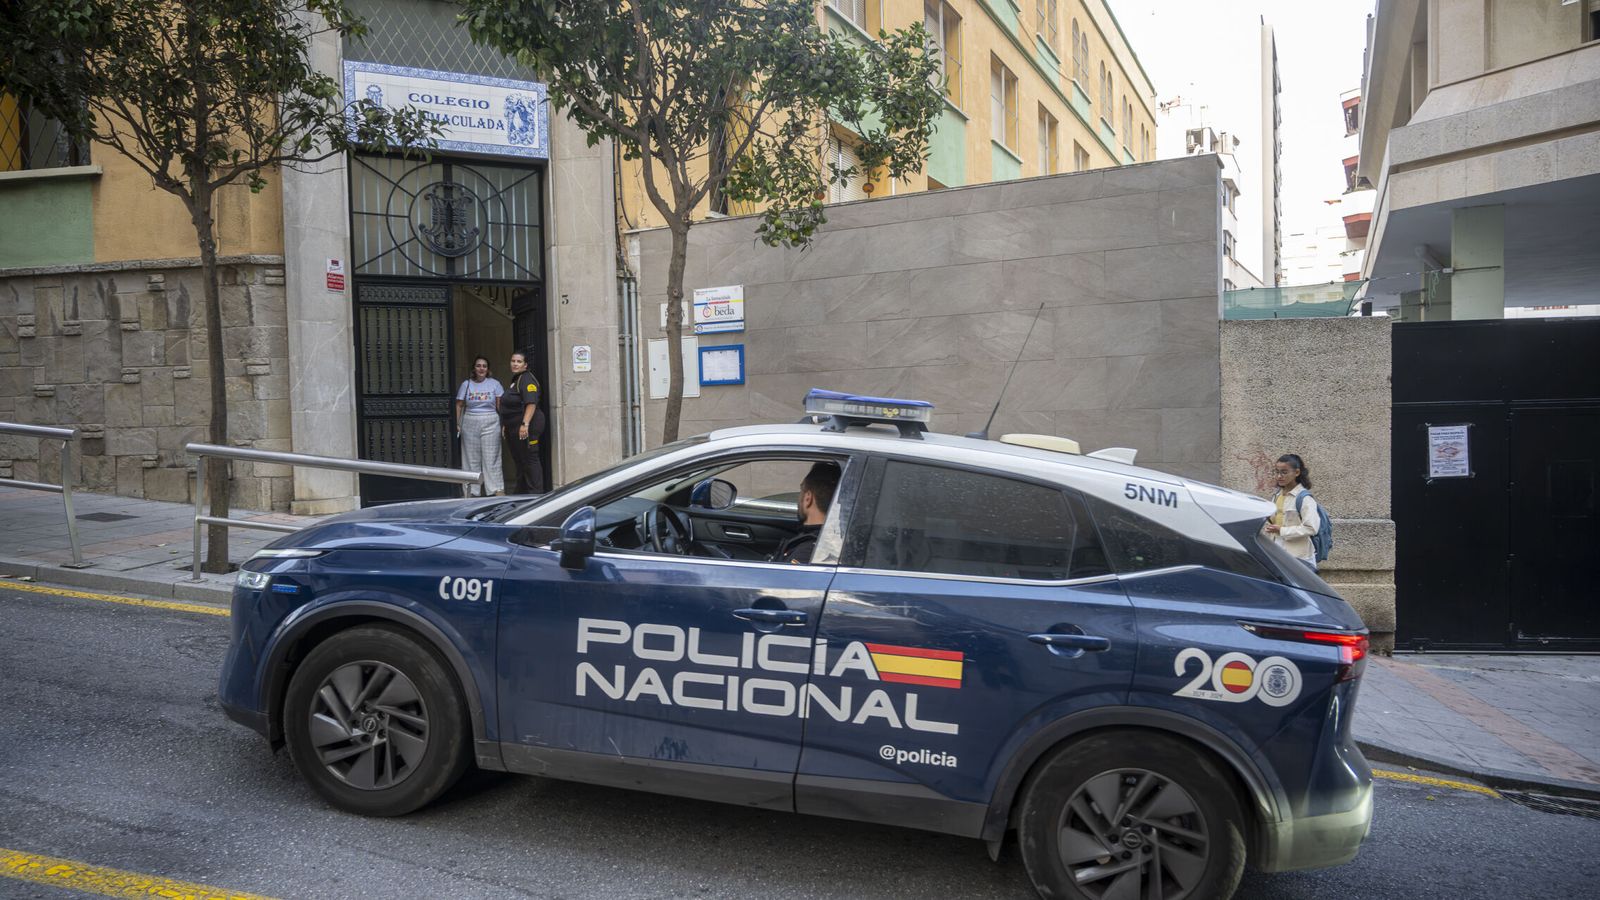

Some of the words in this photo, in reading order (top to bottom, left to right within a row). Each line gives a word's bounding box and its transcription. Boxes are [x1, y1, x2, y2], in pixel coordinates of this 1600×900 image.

[408, 92, 490, 110] COLEGIO
[418, 110, 505, 131] MACULADA
[714, 304, 735, 316] beda
[1124, 483, 1178, 509] 5NM
[452, 577, 493, 602] 091
[577, 617, 881, 681] POLICIA
[576, 661, 959, 735] NACIONAL
[879, 744, 958, 769] @policia
